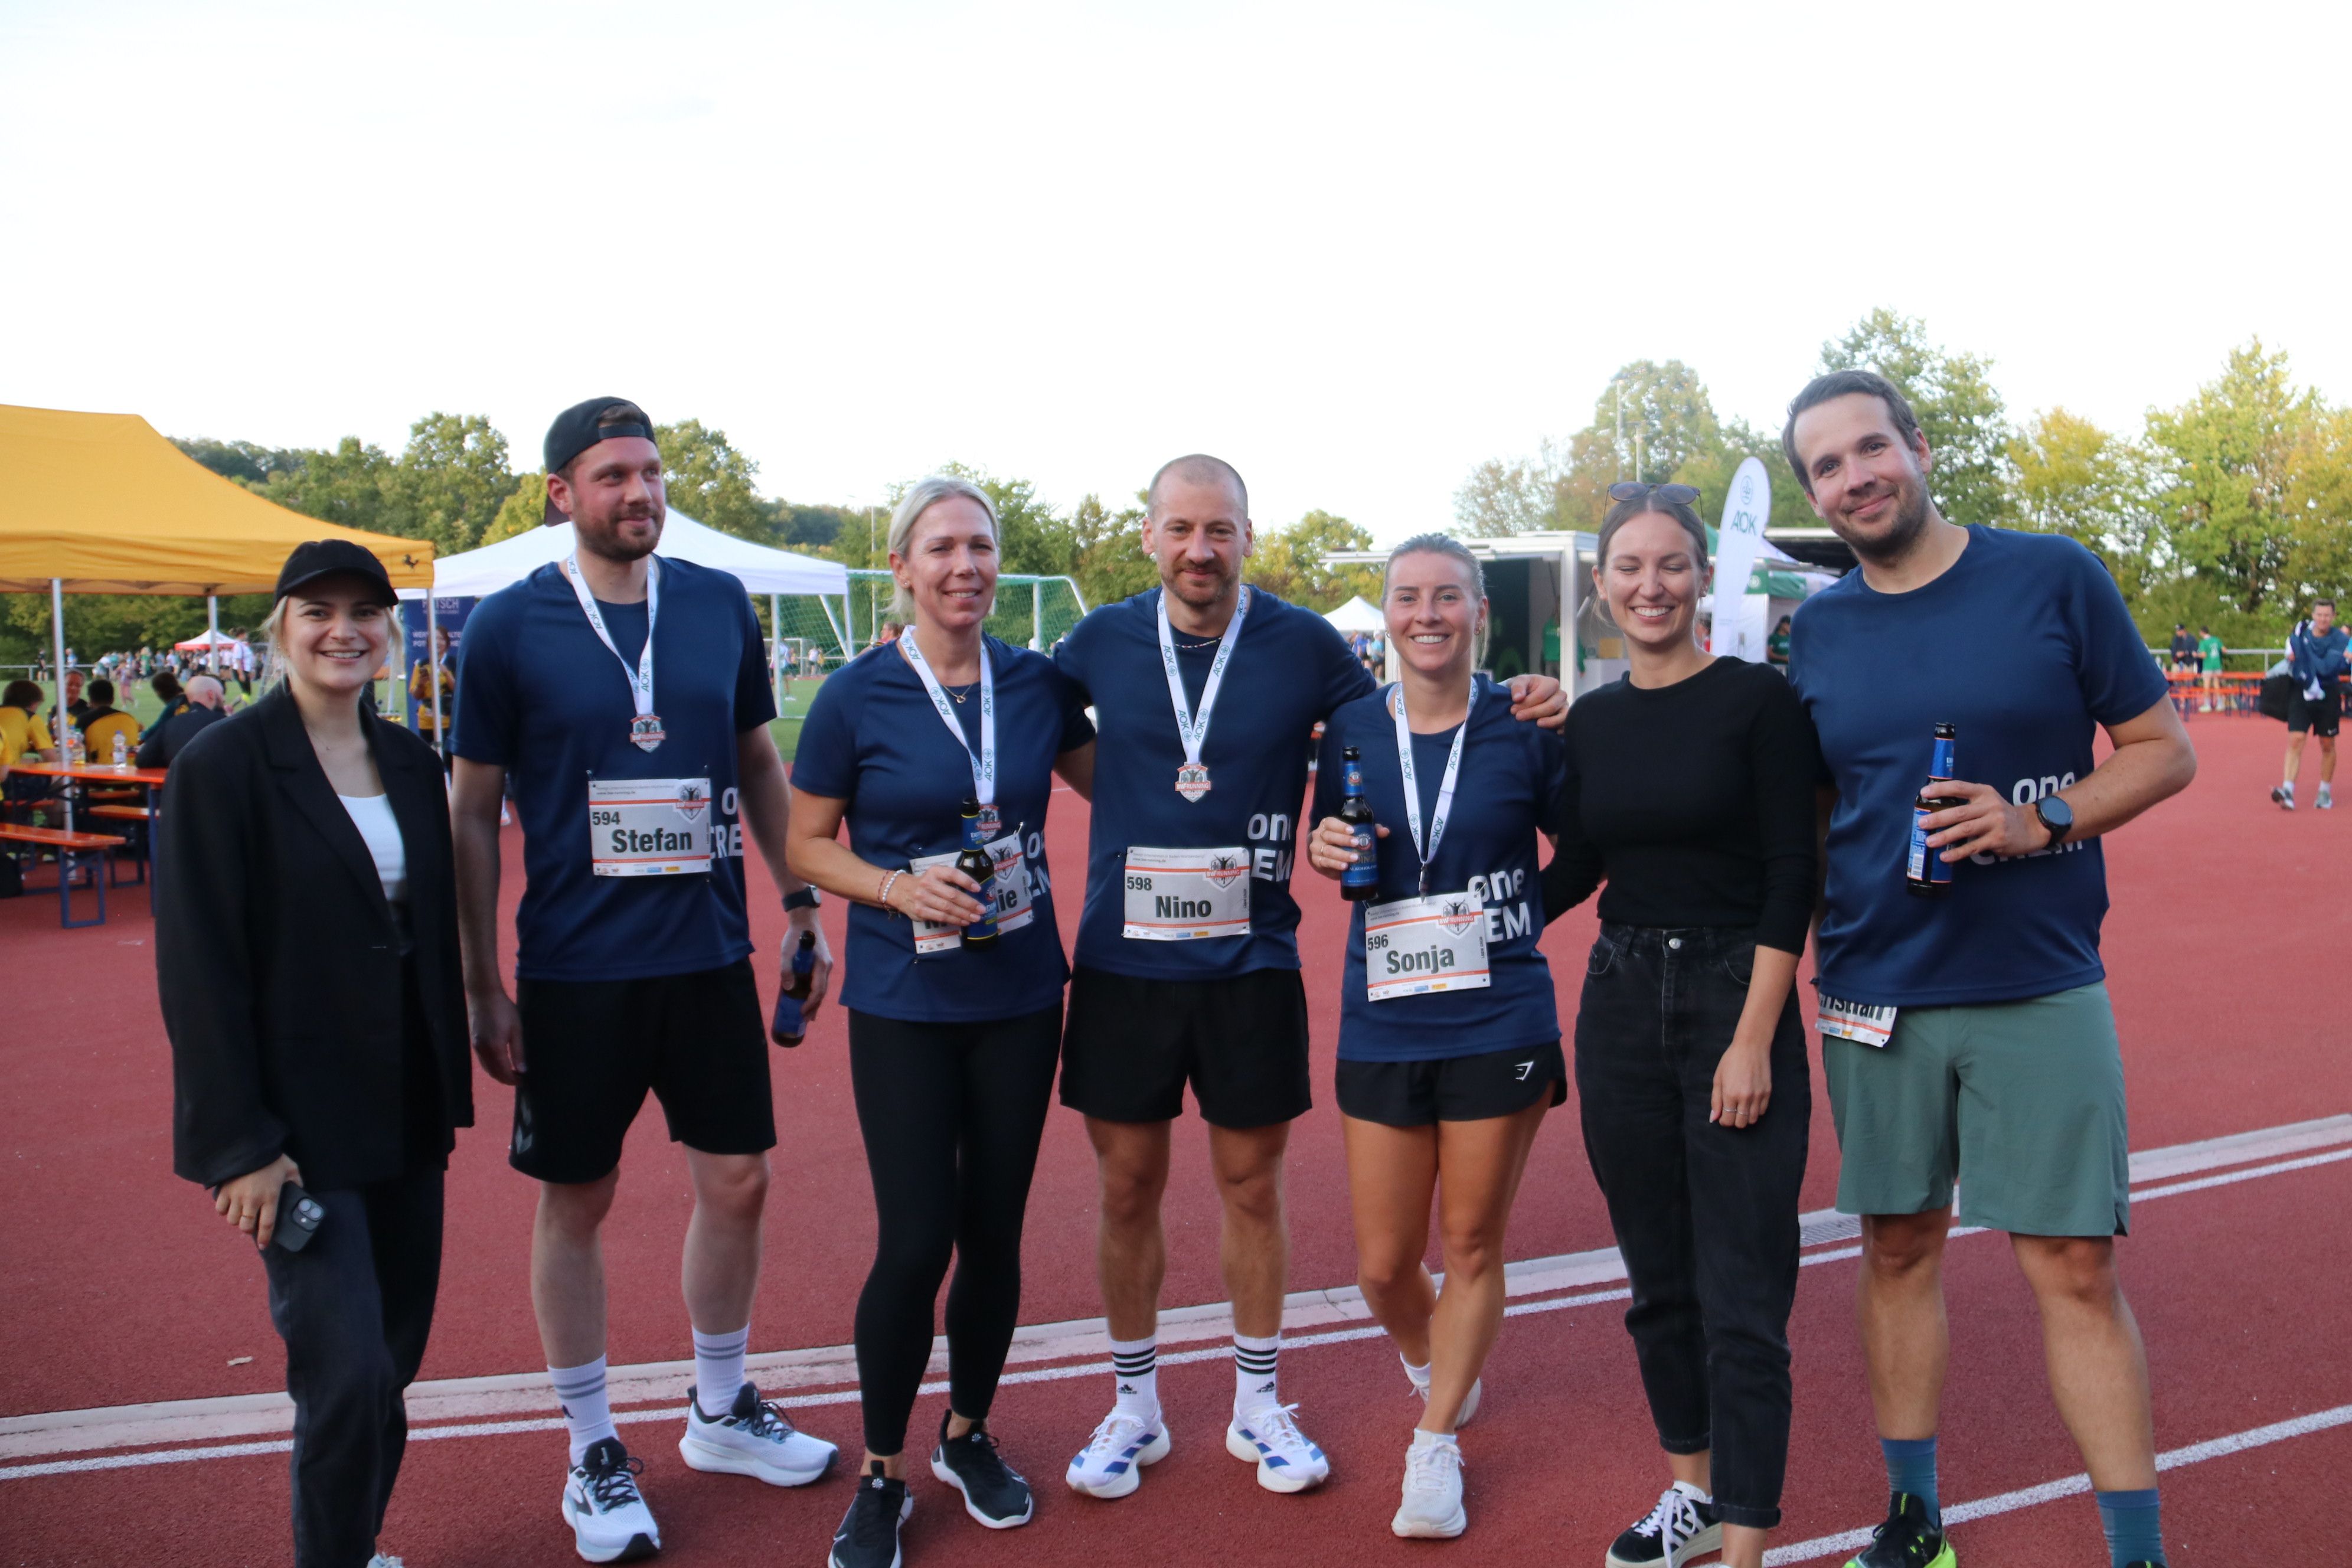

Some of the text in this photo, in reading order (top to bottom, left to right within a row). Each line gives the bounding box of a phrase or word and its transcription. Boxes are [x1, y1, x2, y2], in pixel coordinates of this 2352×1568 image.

[1731, 510, 1758, 536] AOK
[589, 610, 603, 629] AOK
[906, 643, 922, 659] AOK
[1162, 645, 1174, 665] AOK
[1213, 655, 1226, 677] AOK
[641, 671, 649, 692] AOK
[935, 696, 952, 715] AOK
[983, 696, 991, 717] AOK
[1396, 694, 1404, 716] AOK
[1177, 709, 1190, 731] AOK
[1194, 721, 1206, 742] AOK
[1402, 759, 1413, 780] AOK
[1449, 749, 1459, 770] AOK
[984, 760, 992, 782] AOK
[592, 811, 620, 825] 594
[1247, 814, 1291, 841] on
[1432, 815, 1443, 839] AOK
[612, 828, 692, 853] Stefan
[1206, 870, 1240, 878] BW-RUNNING
[1250, 848, 1292, 882] EM
[1127, 876, 1152, 891] 598
[1468, 868, 1525, 903] one
[1155, 896, 1211, 918] Nino
[1439, 914, 1474, 925] BW-RUNNING
[1484, 902, 1531, 943] EM
[1367, 934, 1389, 951] 596
[1386, 945, 1455, 974] Sonja
